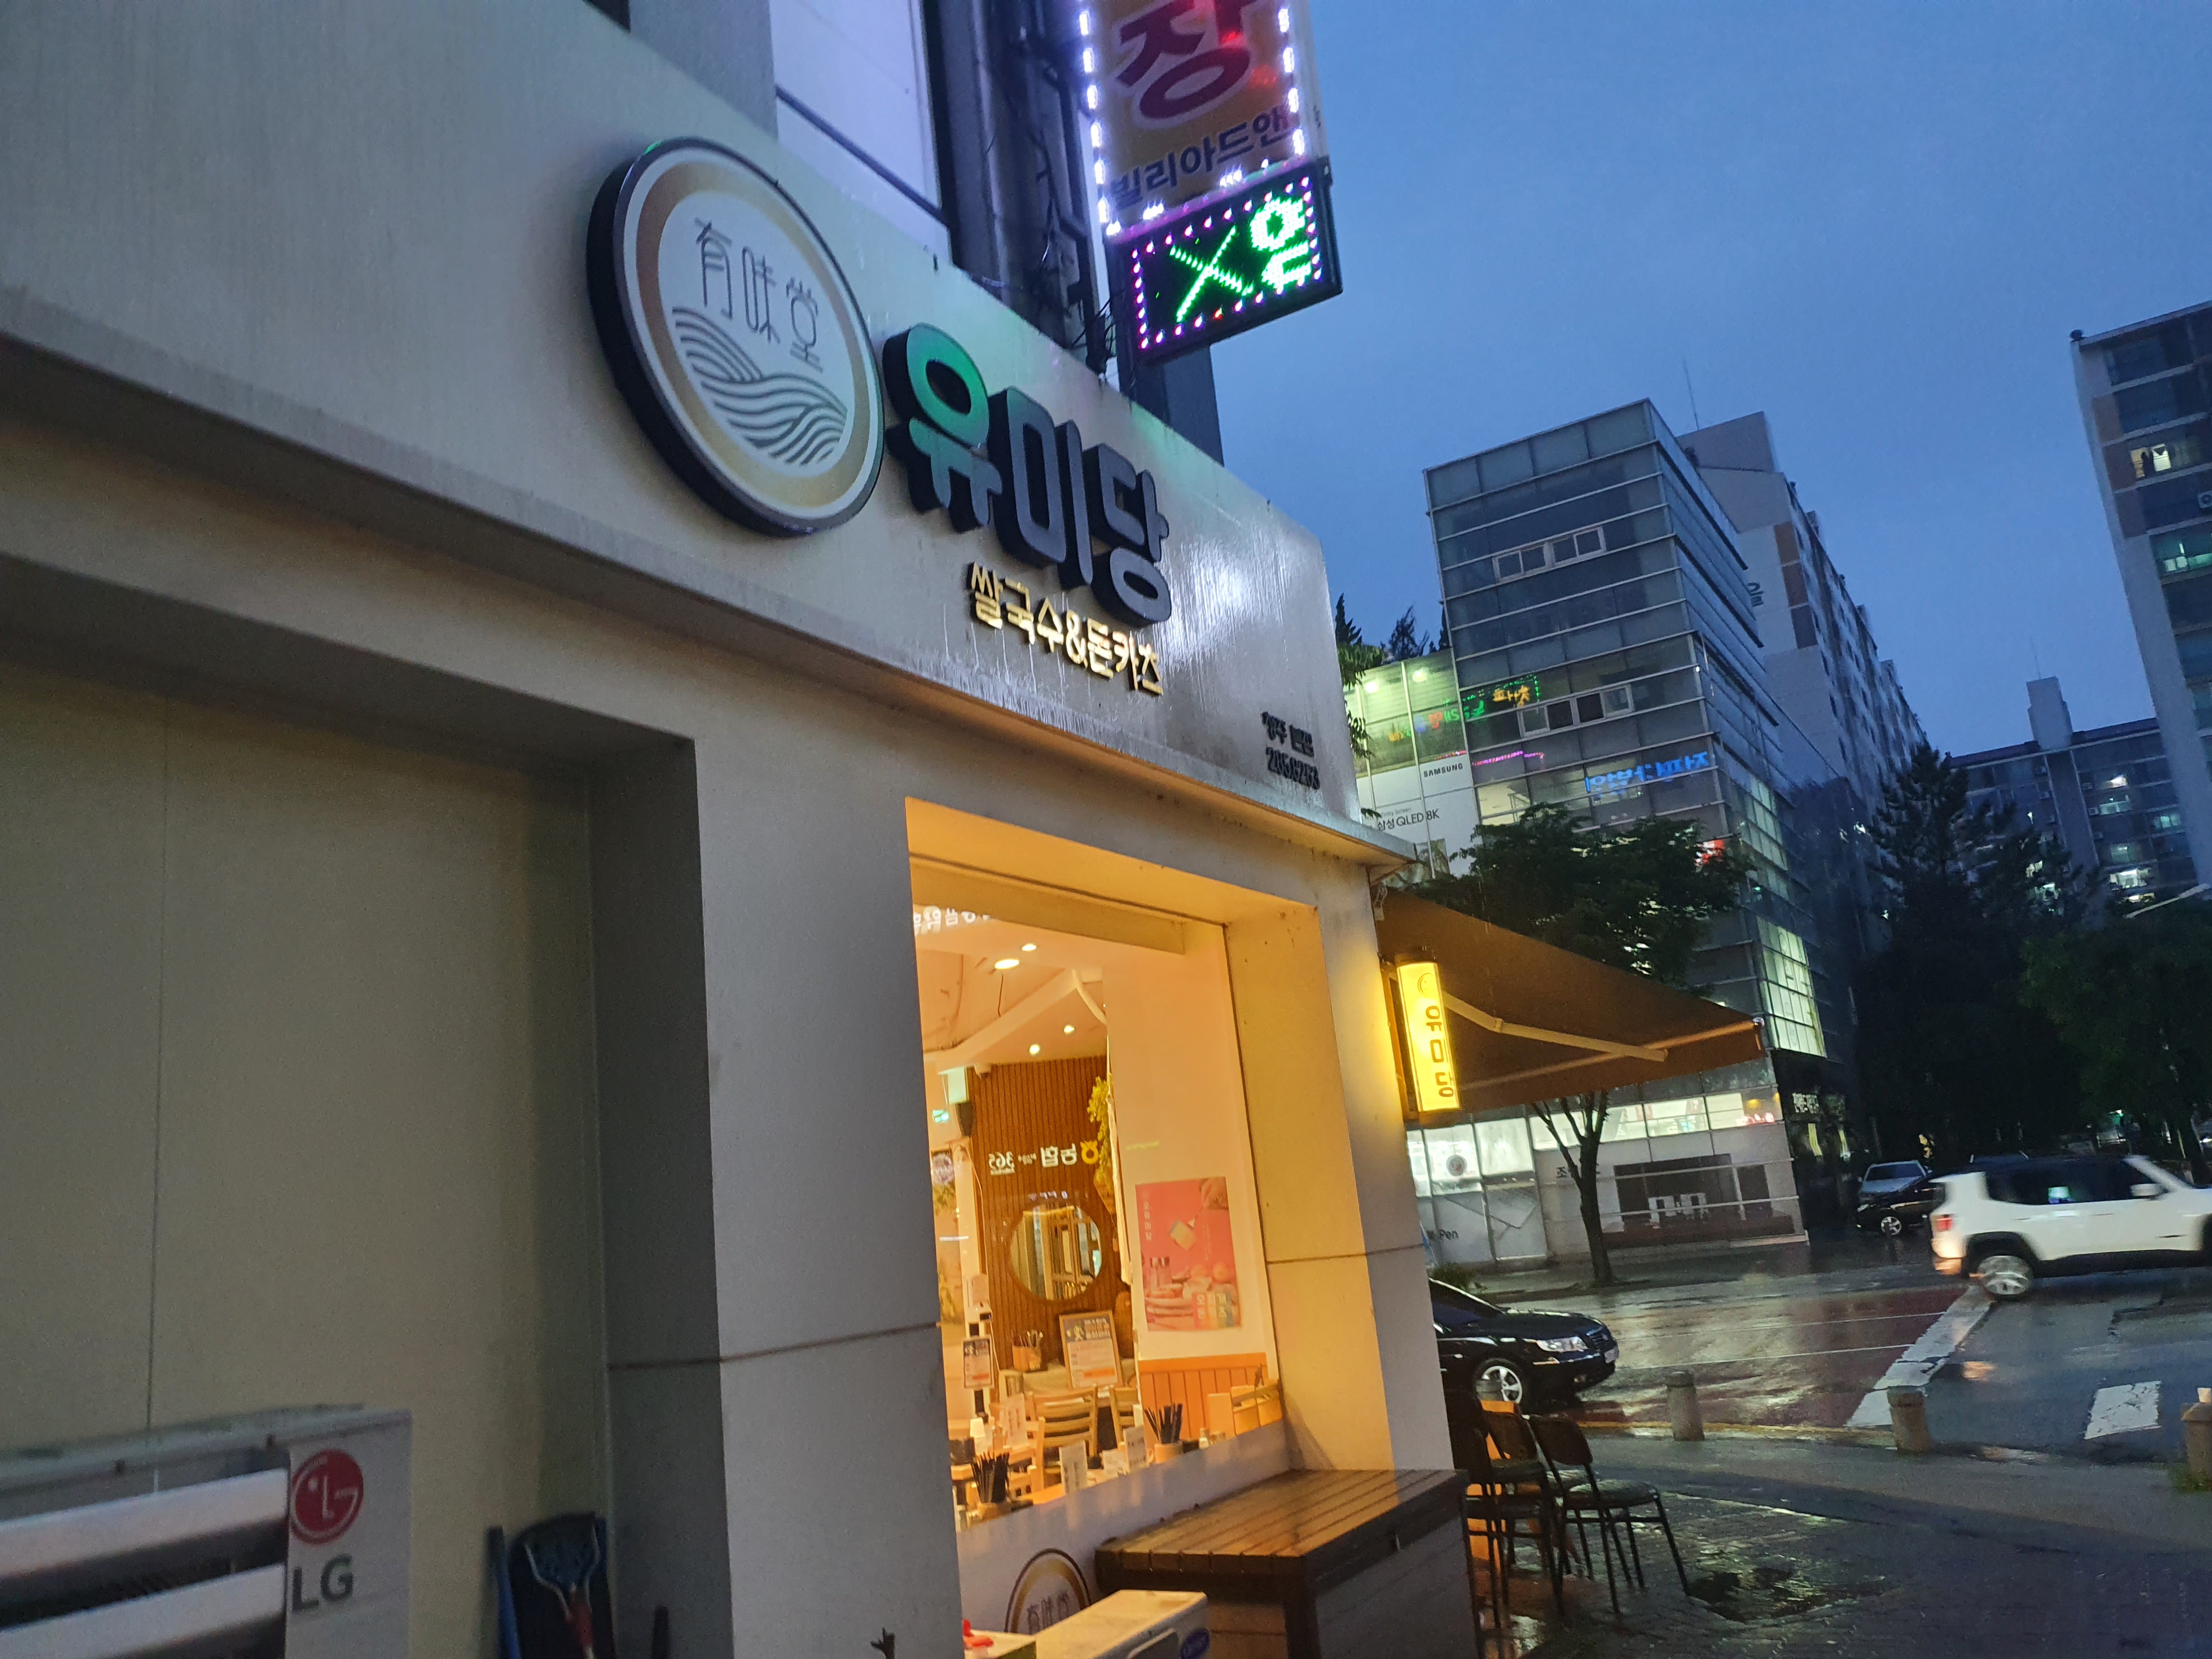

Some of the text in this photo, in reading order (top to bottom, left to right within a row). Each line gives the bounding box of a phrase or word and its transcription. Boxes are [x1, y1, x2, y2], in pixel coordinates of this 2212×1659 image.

[900, 320, 1172, 622] 유미당
[968, 561, 1164, 696] 쌀국수&돈카츠
[1424, 762, 1464, 778] SAMSUNG
[1396, 812, 1424, 827] QLED
[1426, 808, 1440, 821] 8K
[1425, 1006, 1455, 1098] 유미당
[291, 1553, 356, 1613] LG
